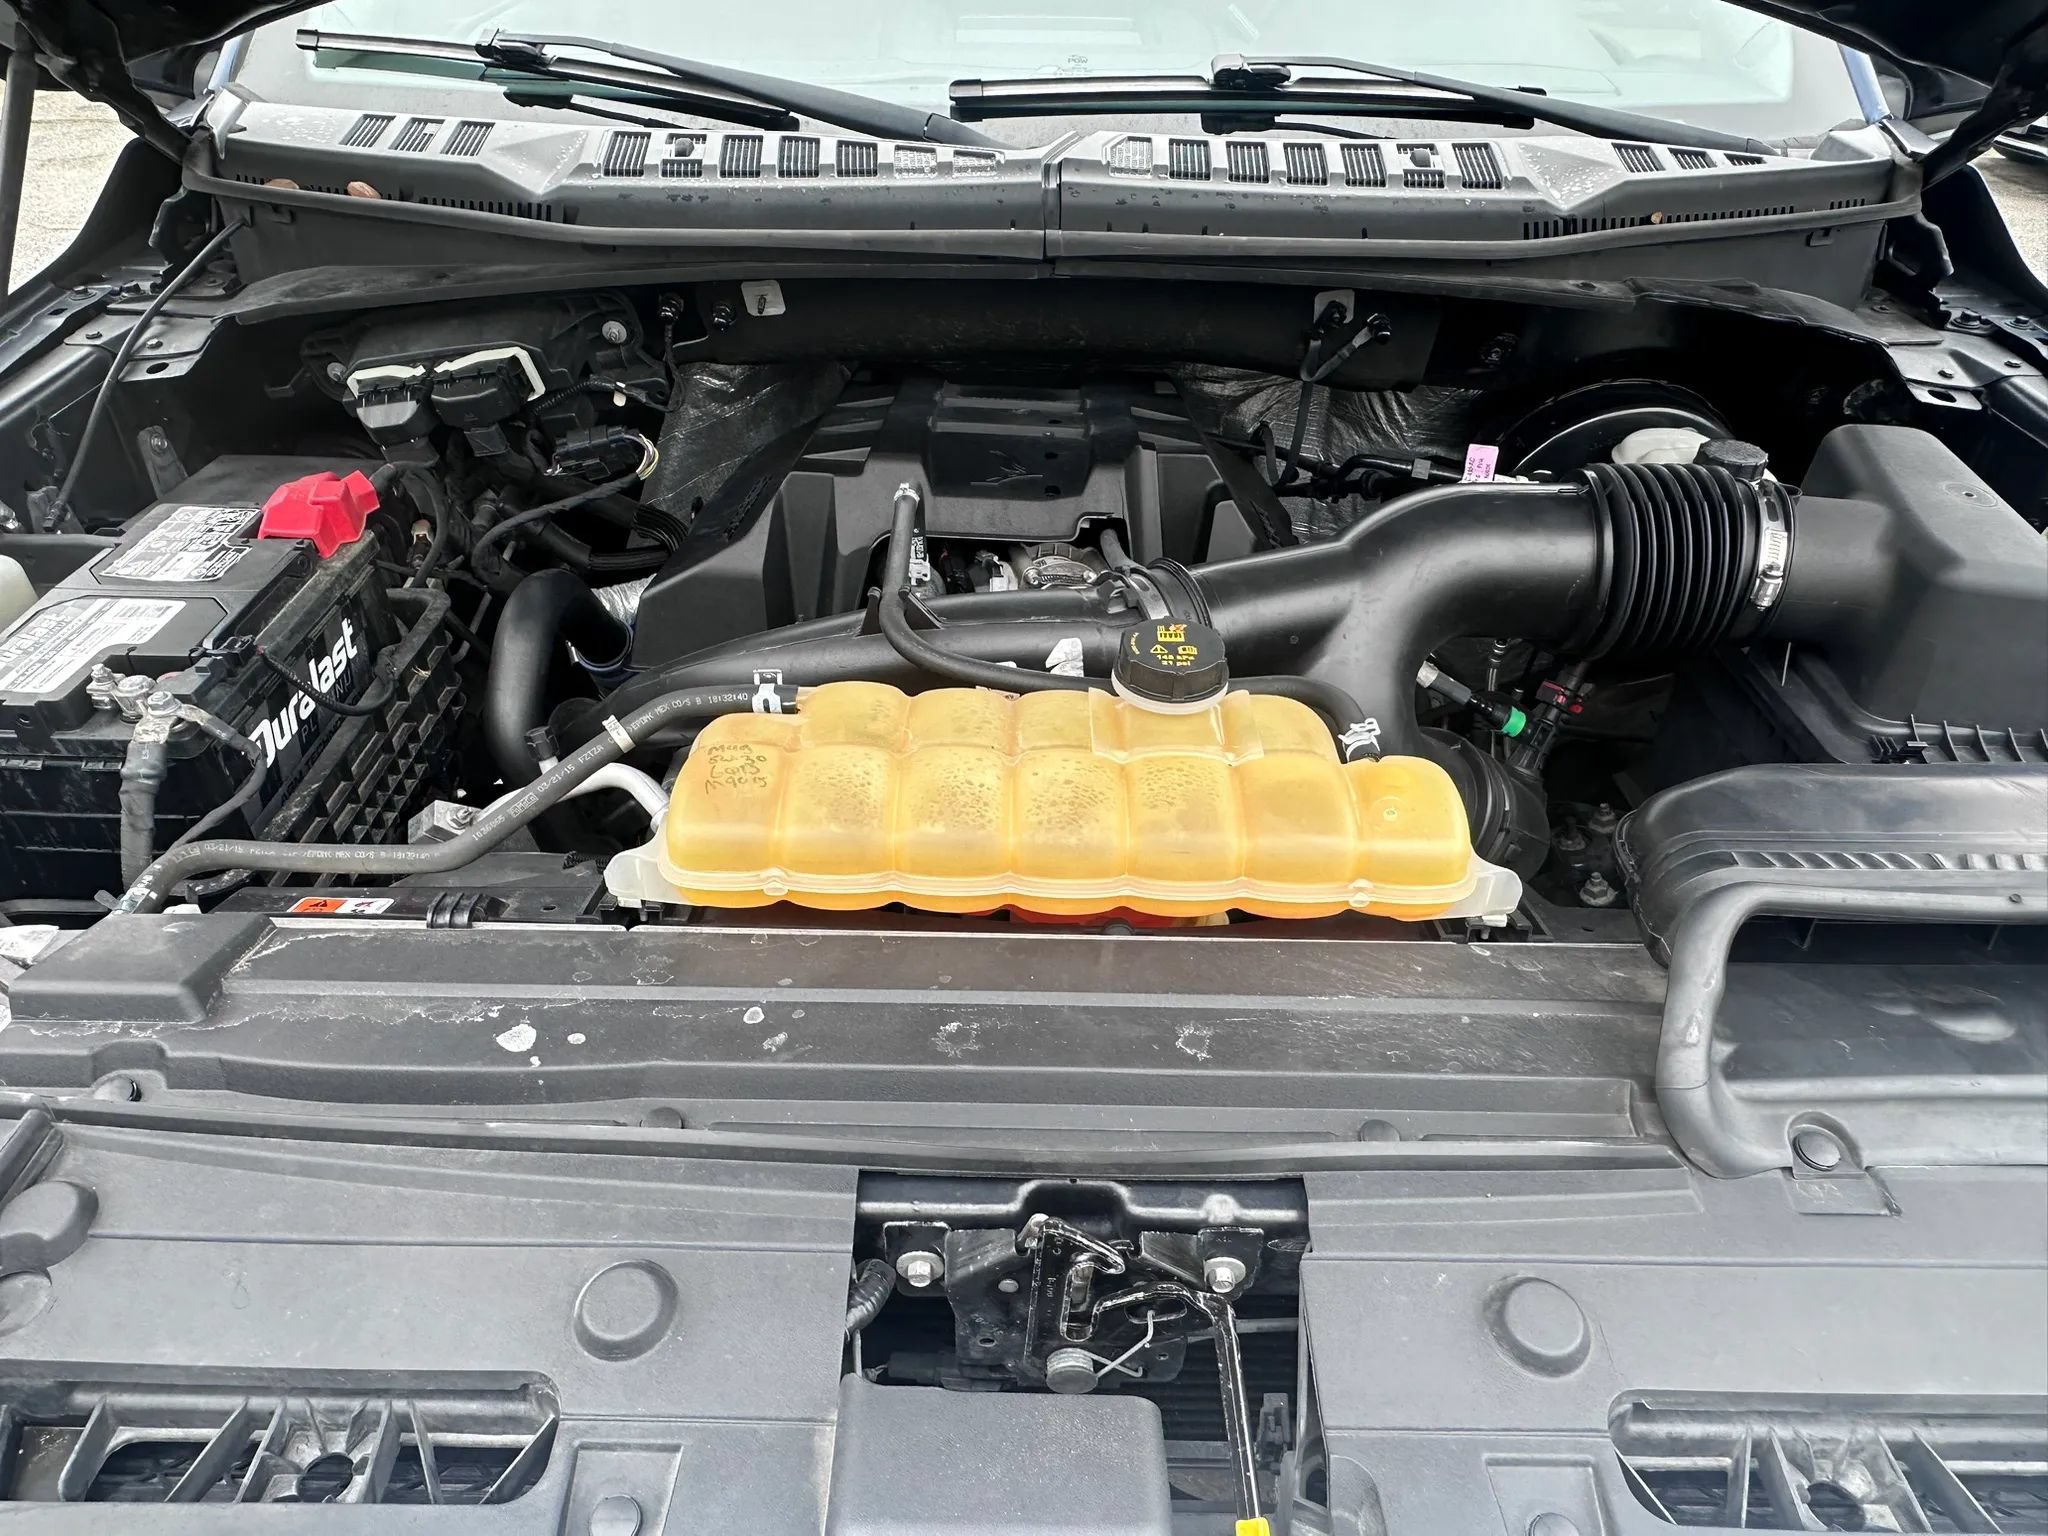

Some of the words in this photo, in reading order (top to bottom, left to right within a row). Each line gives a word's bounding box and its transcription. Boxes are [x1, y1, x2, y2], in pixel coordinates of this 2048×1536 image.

[248, 618, 358, 768] Duralast
[537, 763, 576, 793] 03/21/15
[655, 704, 671, 719] MEX
